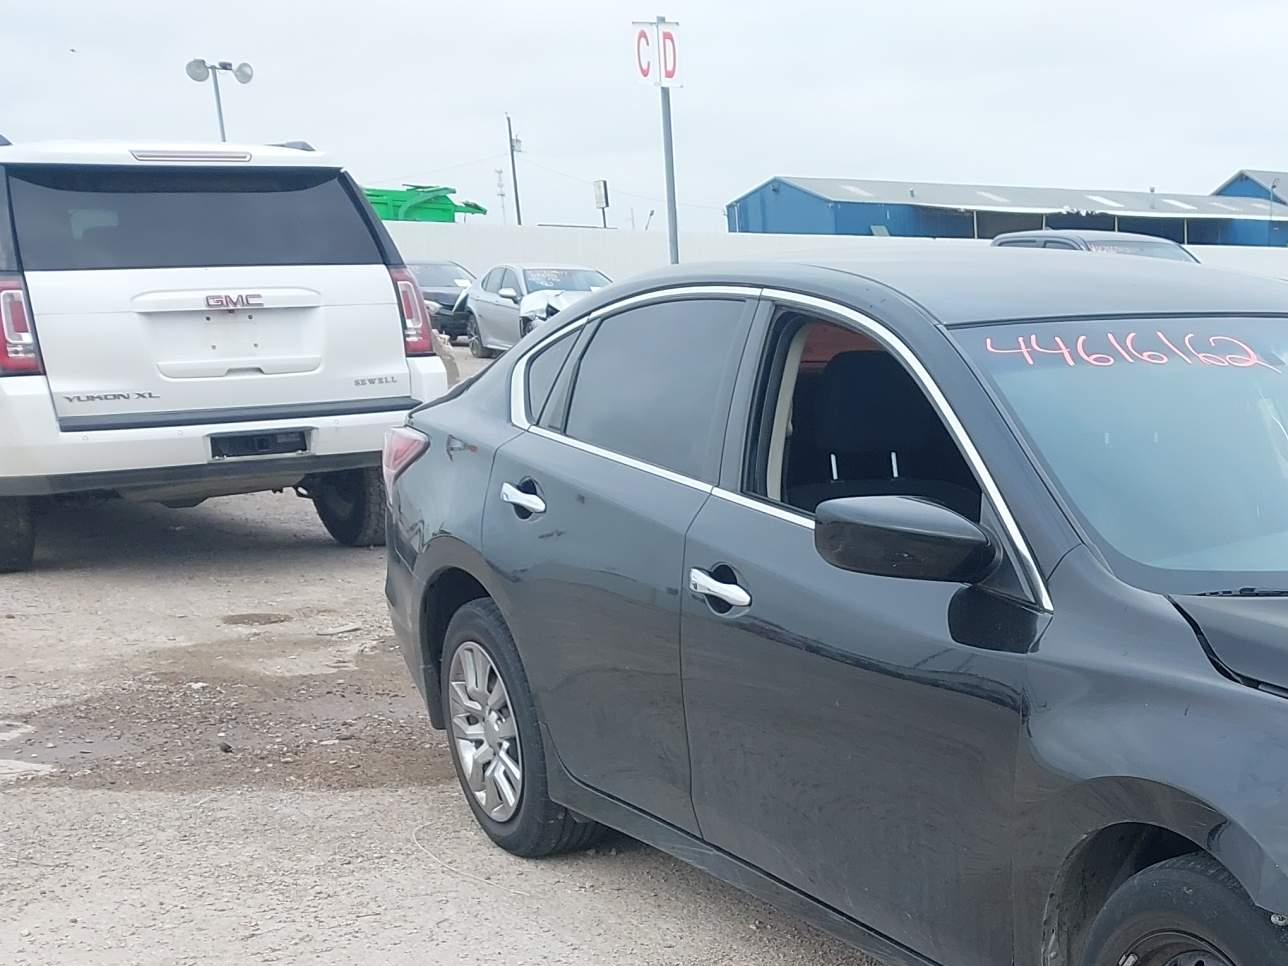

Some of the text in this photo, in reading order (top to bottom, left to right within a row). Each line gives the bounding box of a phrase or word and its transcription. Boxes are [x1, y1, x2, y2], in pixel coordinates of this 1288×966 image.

[637, 29, 676, 78] C D
[205, 294, 264, 308] GMC
[986, 331, 1282, 374] 44616162
[353, 376, 398, 386] SEWELL
[64, 392, 160, 403] YUKON XL
